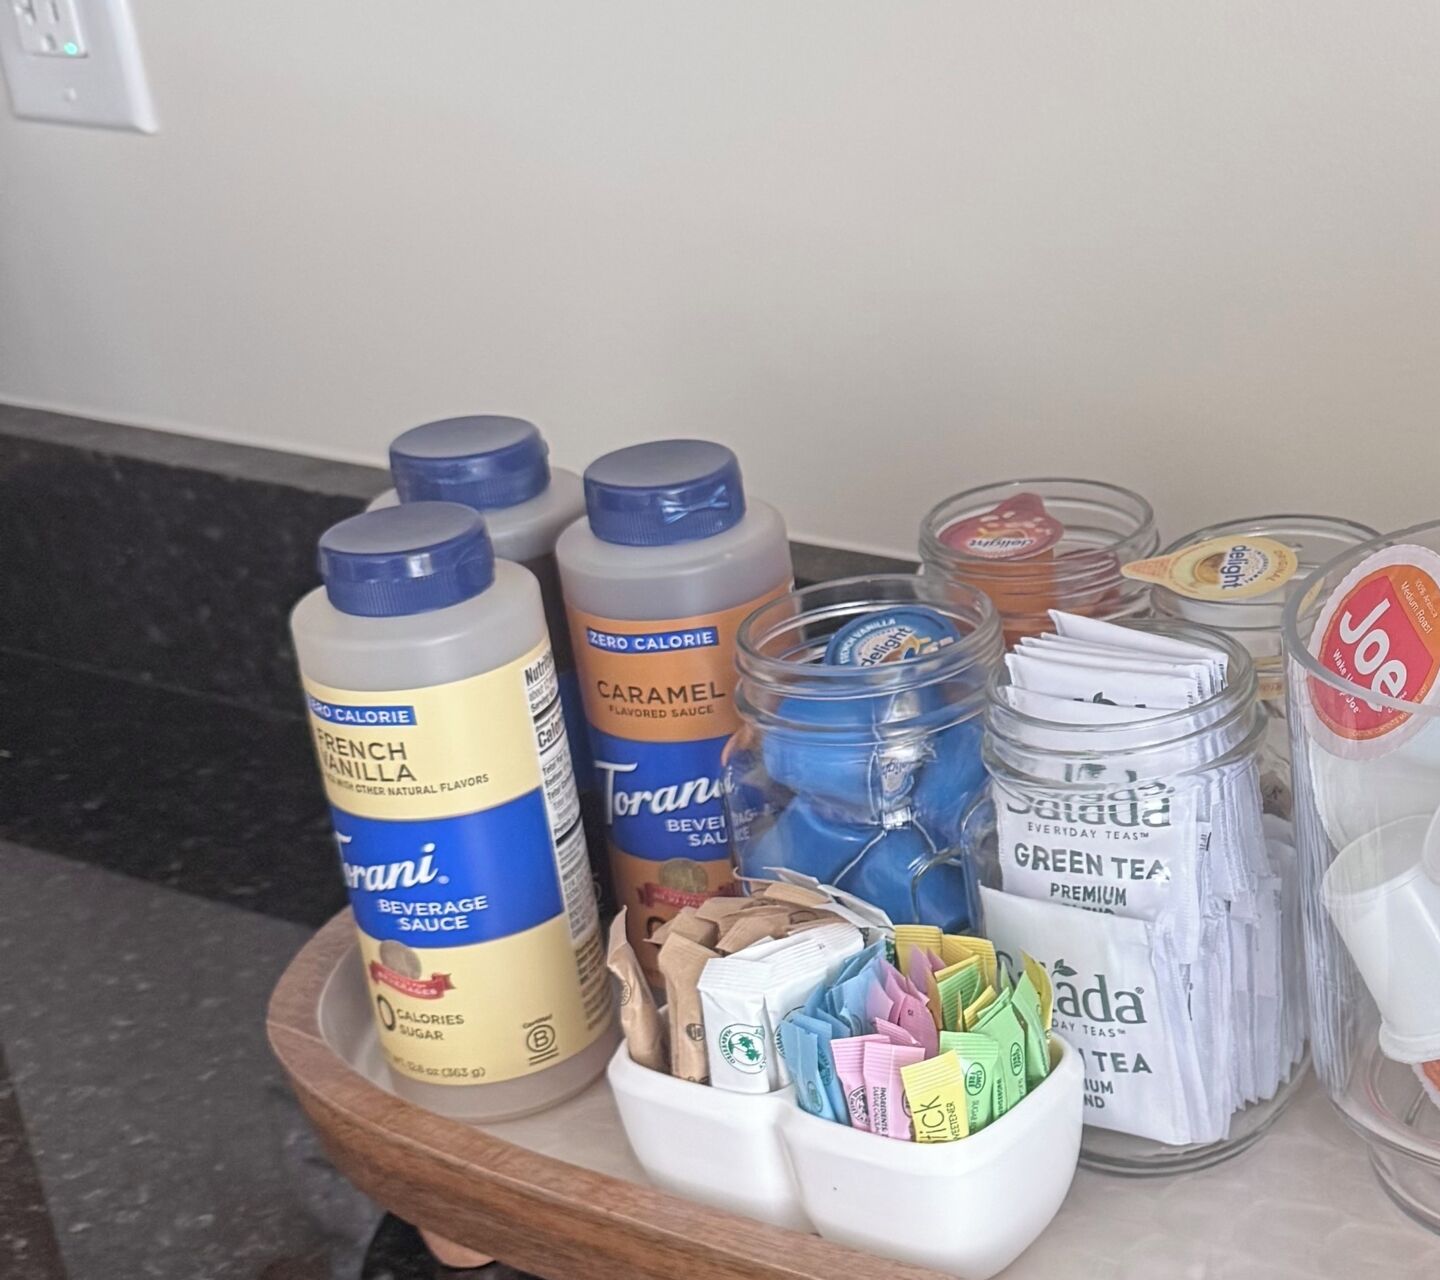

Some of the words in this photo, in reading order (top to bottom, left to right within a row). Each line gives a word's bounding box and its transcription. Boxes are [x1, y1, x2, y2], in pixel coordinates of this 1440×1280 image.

[1220, 544, 1251, 590] delight
[1400, 581, 1419, 613] Medium
[1416, 609, 1433, 634] Roast
[855, 618, 896, 638] VANILLA
[589, 631, 628, 649] ZERO
[634, 631, 714, 651] CALORIE
[861, 626, 913, 667] delight
[1339, 598, 1408, 713] Joe
[596, 680, 727, 706] CARAMEL
[1332, 648, 1348, 676] Wake
[1346, 694, 1361, 714] Joe
[335, 708, 410, 724] CALORIE
[608, 704, 668, 719] FLAVORED
[671, 704, 715, 717] SAUCE
[316, 727, 408, 761] FRENCH
[322, 757, 418, 783] VANILLA
[355, 784, 386, 797] OTHER
[387, 784, 438, 797] NATURAL
[440, 773, 490, 793] FLAVORS
[1027, 821, 1098, 839] EVERYDAY
[1014, 842, 1104, 877] GREEN
[1110, 856, 1171, 881] TEA
[378, 895, 489, 917] BEVERAGE
[1050, 882, 1128, 907] PREMIUM
[398, 915, 470, 933] SAUCE
[396, 1008, 466, 1026] CALORIES
[399, 1024, 445, 1041] SUGAR
[471, 1066, 487, 1079] g)
[1091, 1050, 1153, 1074] TEA
[975, 1070, 983, 1089] GMO
[913, 1095, 949, 1142] tick
